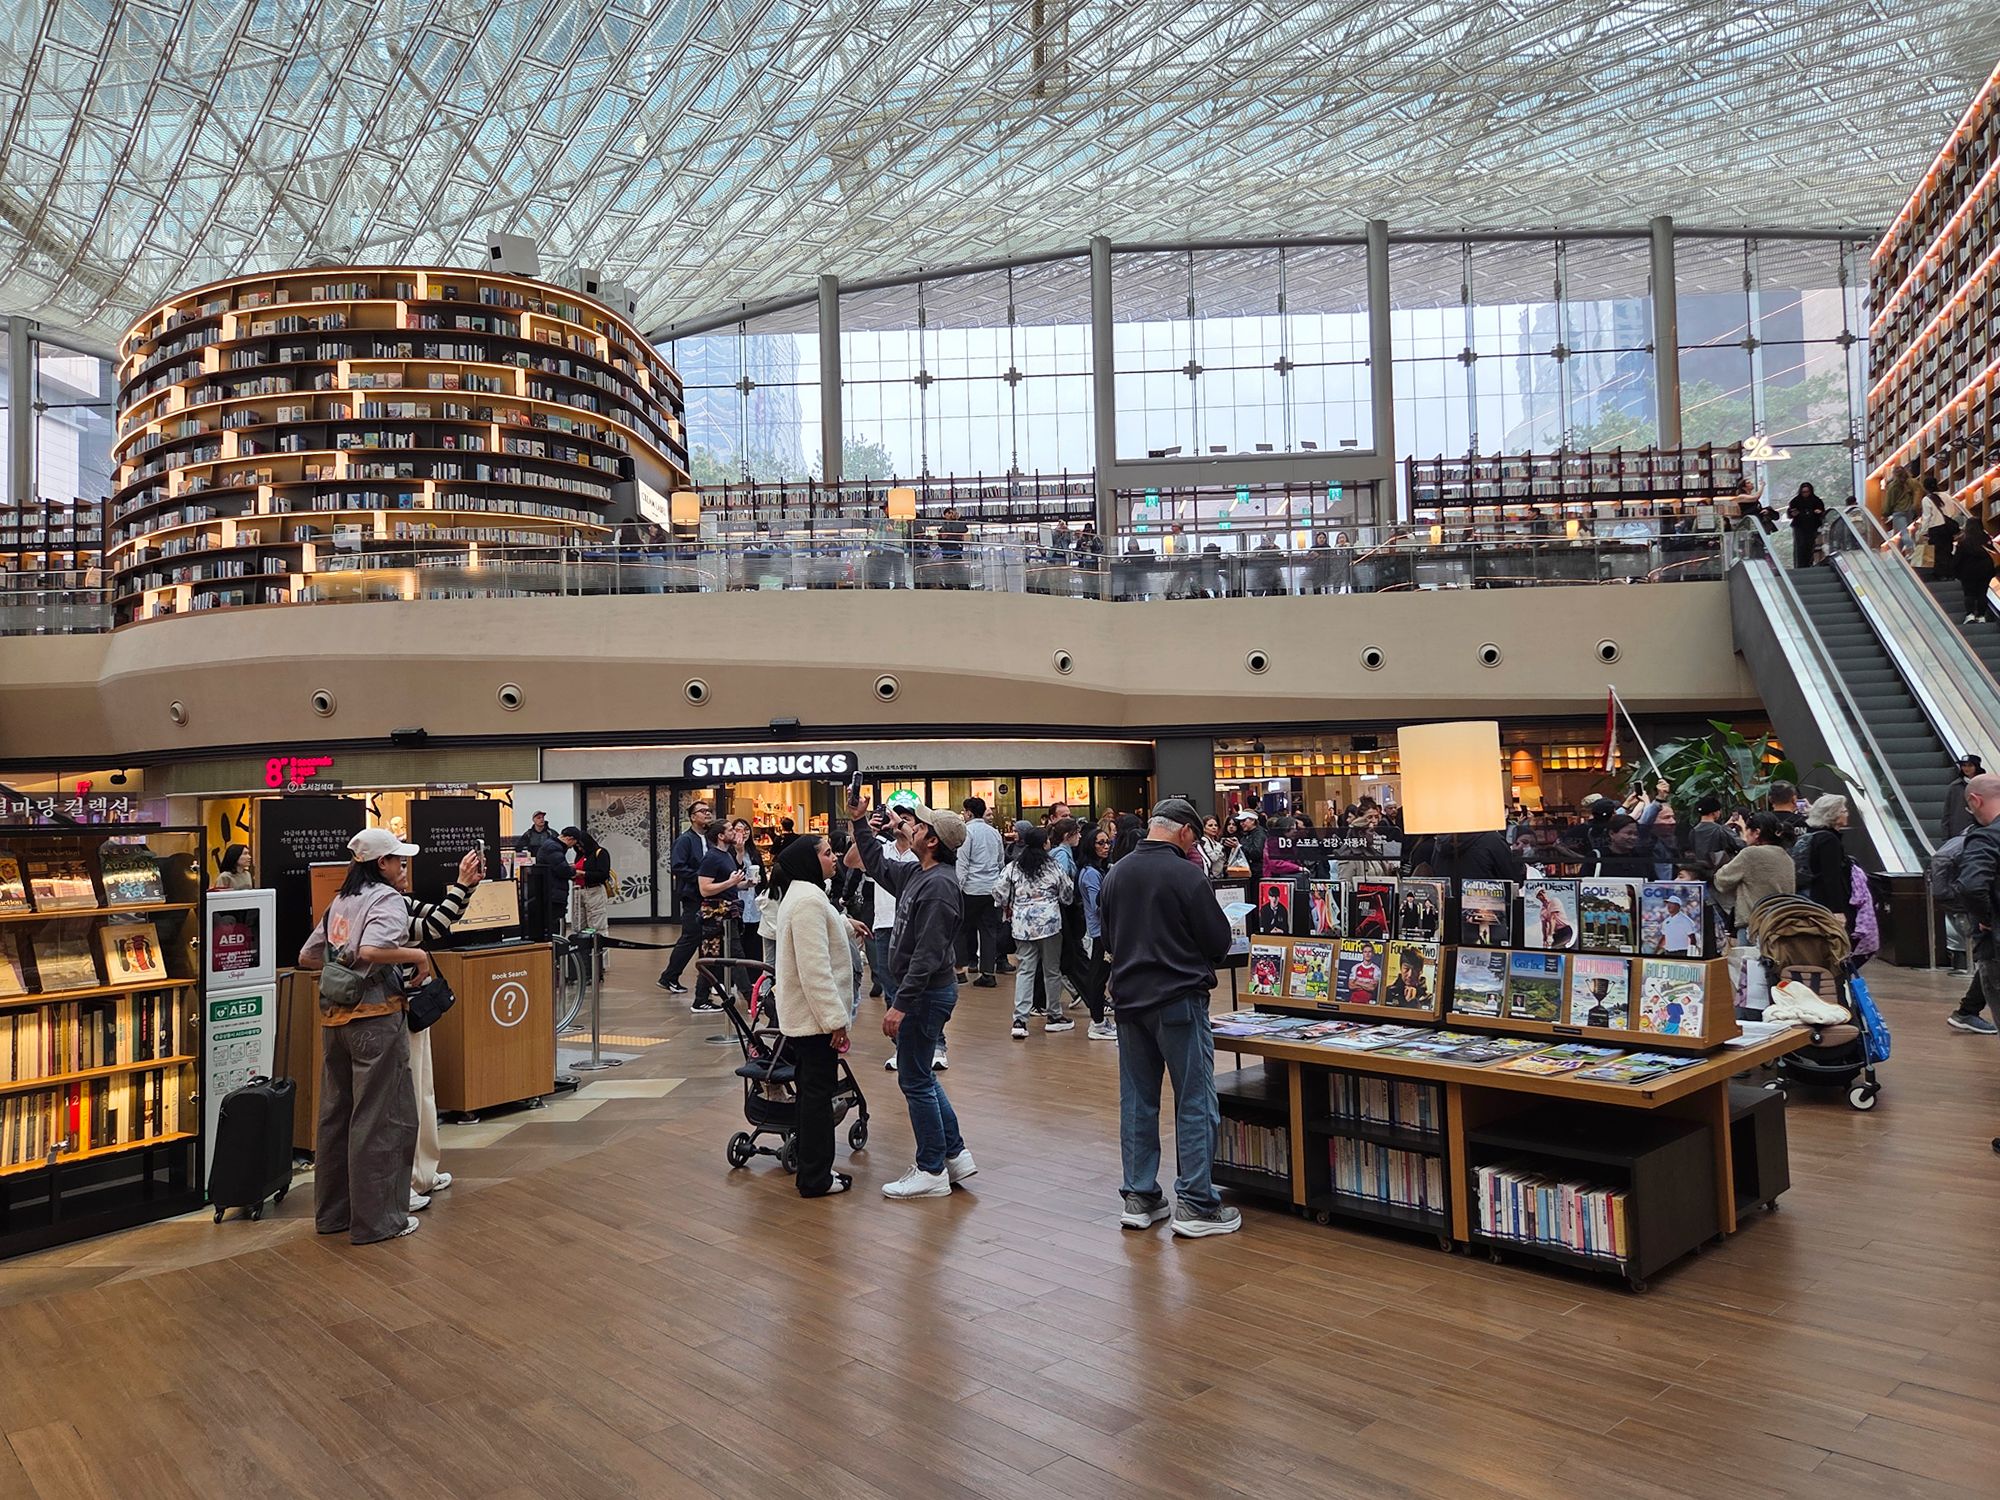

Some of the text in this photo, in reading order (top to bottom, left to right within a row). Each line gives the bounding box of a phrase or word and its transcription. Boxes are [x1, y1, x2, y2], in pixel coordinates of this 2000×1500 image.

[692, 754, 848, 778] STARBUCKS
[300, 783, 334, 791] 도서검색대
[64, 796, 130, 818] 컬렉션
[1279, 837, 1292, 849] D3
[110, 889, 160, 899] SALE
[1582, 886, 1609, 897] GOLF
[219, 934, 245, 945] AED
[508, 970, 528, 978] Search
[229, 1002, 257, 1016] AED
[72, 1095, 79, 1105] 2
